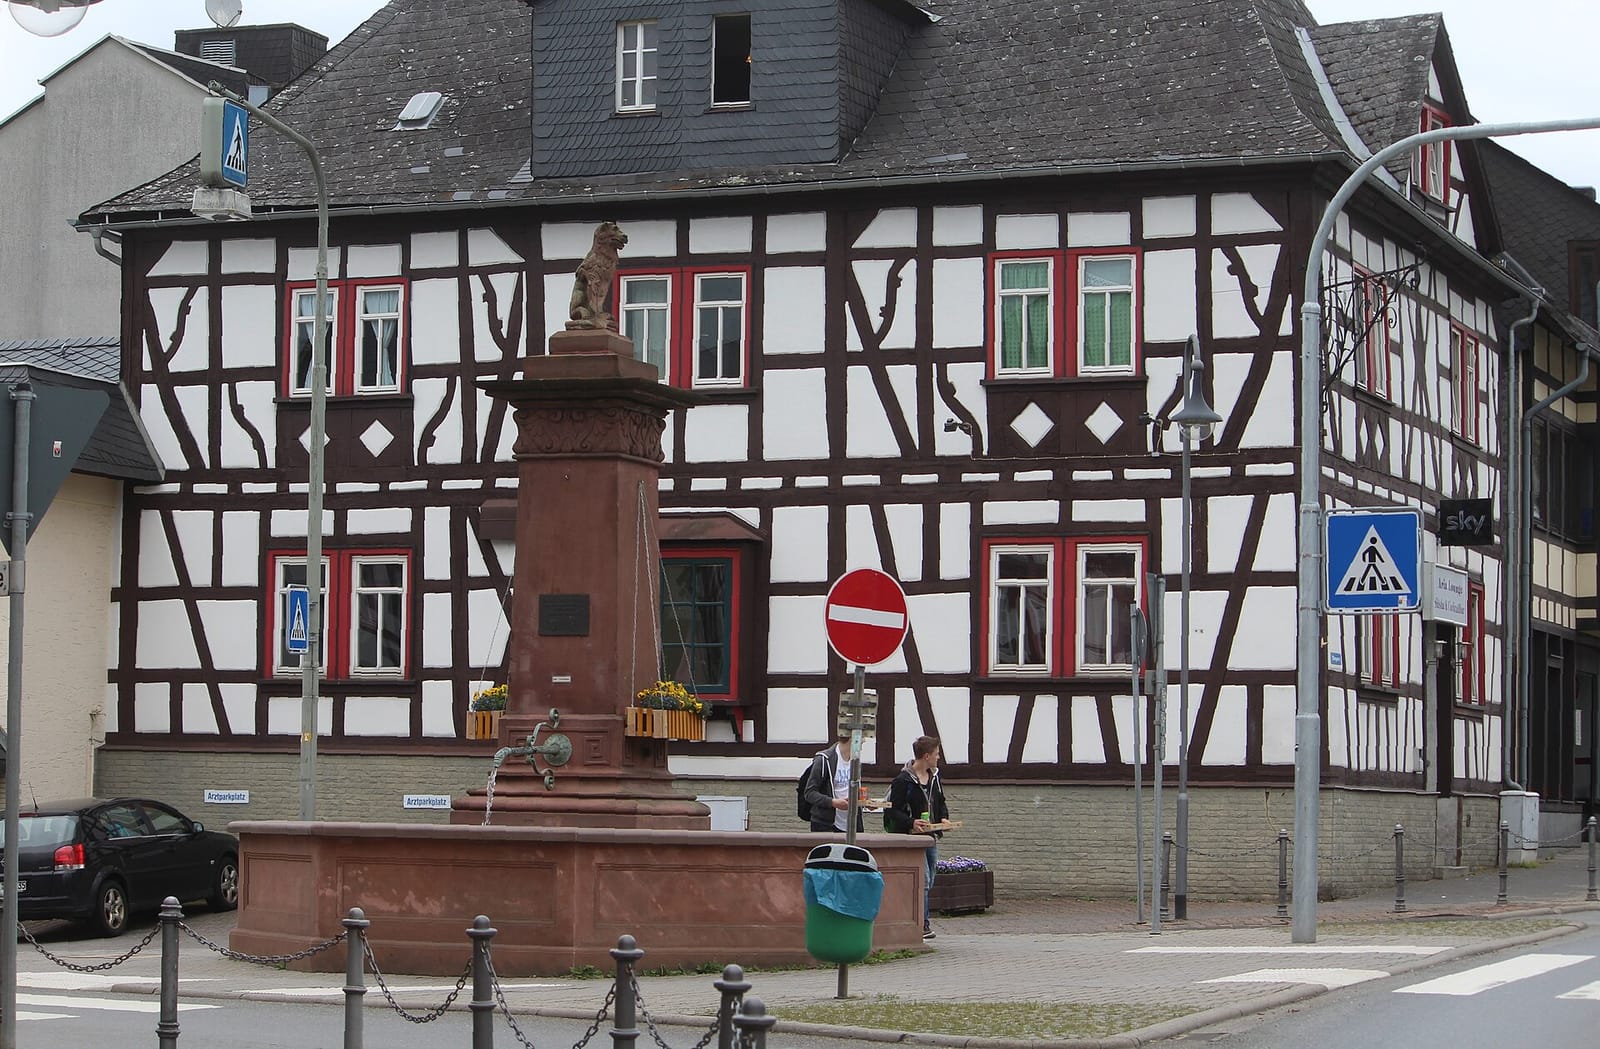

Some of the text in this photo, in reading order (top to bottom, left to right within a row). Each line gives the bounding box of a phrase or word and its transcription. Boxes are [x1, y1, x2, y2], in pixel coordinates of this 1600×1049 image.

[1446, 510, 1486, 536] sky
[207, 792, 246, 802] Arztparkplatz
[406, 797, 447, 807] Arztparkplatz
